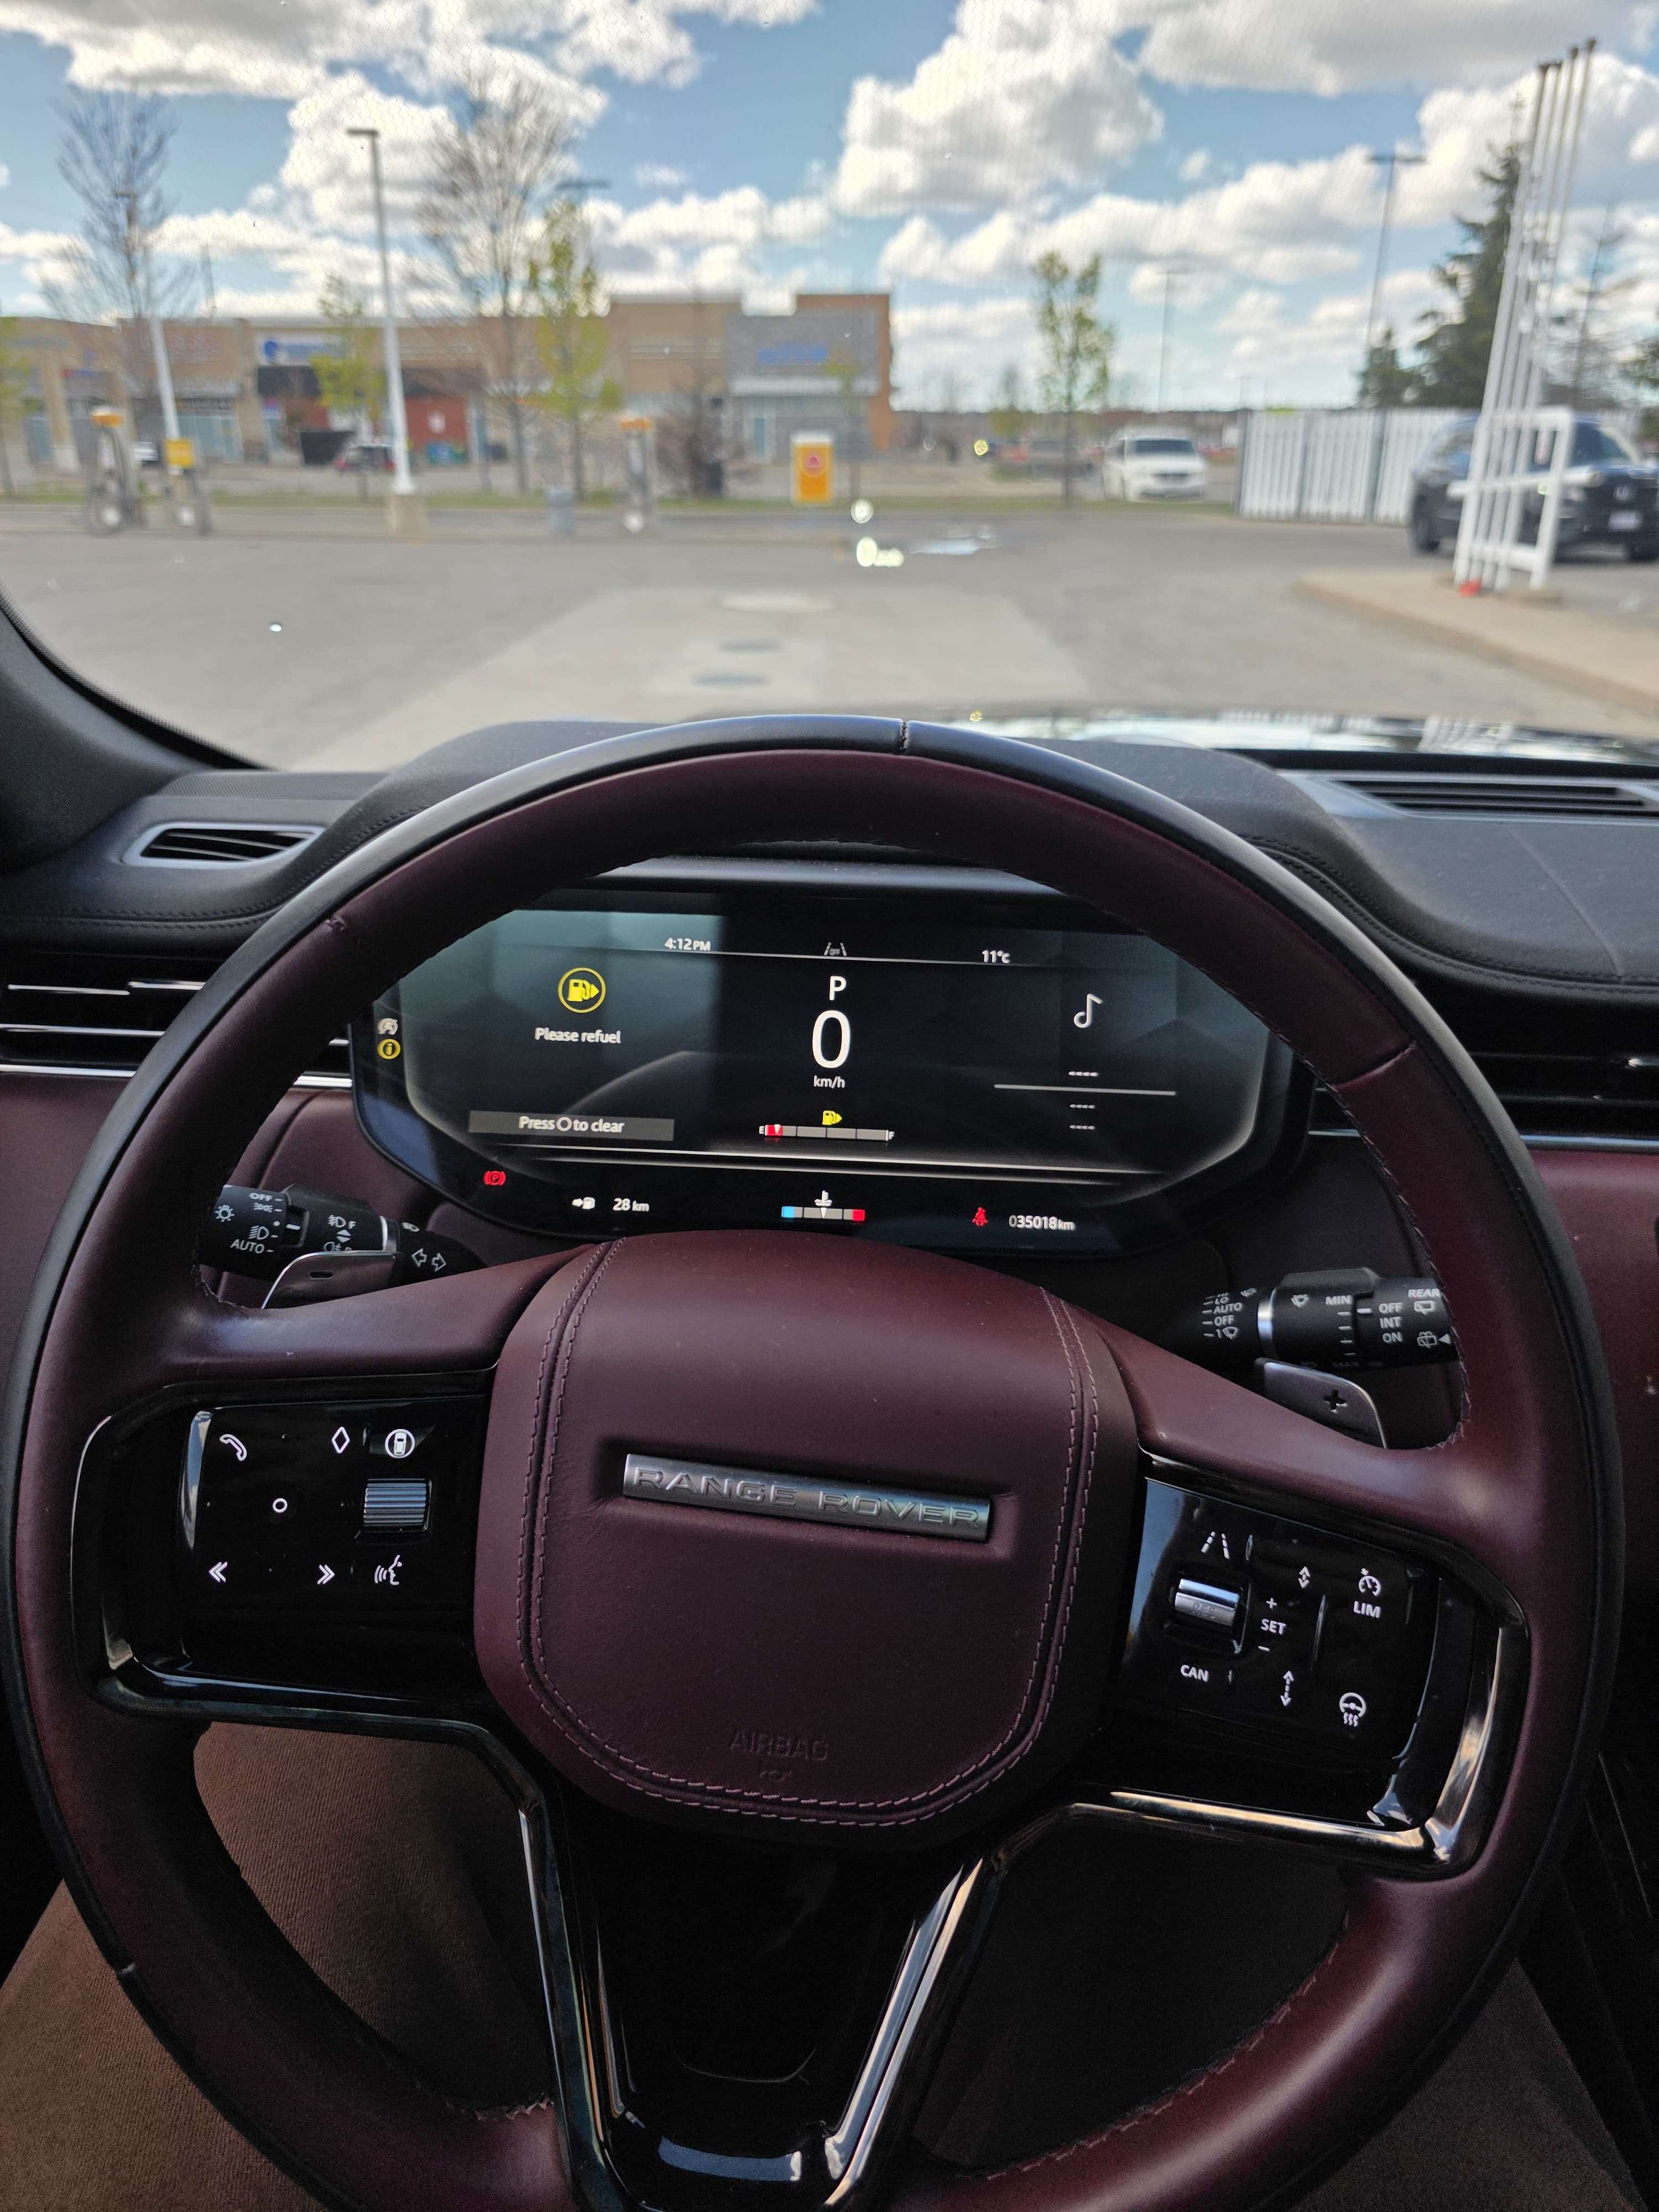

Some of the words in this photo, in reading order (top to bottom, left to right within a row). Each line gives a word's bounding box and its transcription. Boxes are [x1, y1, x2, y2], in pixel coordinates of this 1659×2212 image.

[830, 975, 847, 1000] P
[535, 1027, 579, 1042] Please
[581, 1029, 621, 1044] refuel
[812, 1010, 851, 1068] 0
[813, 1075, 846, 1089] km/h
[519, 1115, 555, 1130] Press
[573, 1119, 588, 1131] to
[591, 1118, 625, 1133] clear
[249, 1193, 273, 1201] OFF
[613, 1198, 630, 1211] 28
[632, 1200, 649, 1212] km
[230, 1239, 264, 1254] AUTO
[1326, 1295, 1352, 1305] MIN
[1408, 1288, 1441, 1298] REAR
[1213, 1302, 1242, 1314] AUTO
[1379, 1302, 1402, 1314] OFF
[1214, 1315, 1234, 1326] OFF
[1380, 1317, 1401, 1328] INT
[1383, 1332, 1403, 1343] ON
[633, 1467, 797, 1506] RANGE
[818, 1490, 978, 1528] ROVER
[1192, 1602, 1217, 1619] RES
[1353, 1600, 1381, 1619] LIM
[1261, 1618, 1286, 1635] SET
[1180, 1665, 1209, 1682] CAN
[730, 1731, 828, 1761] AIRBAG
